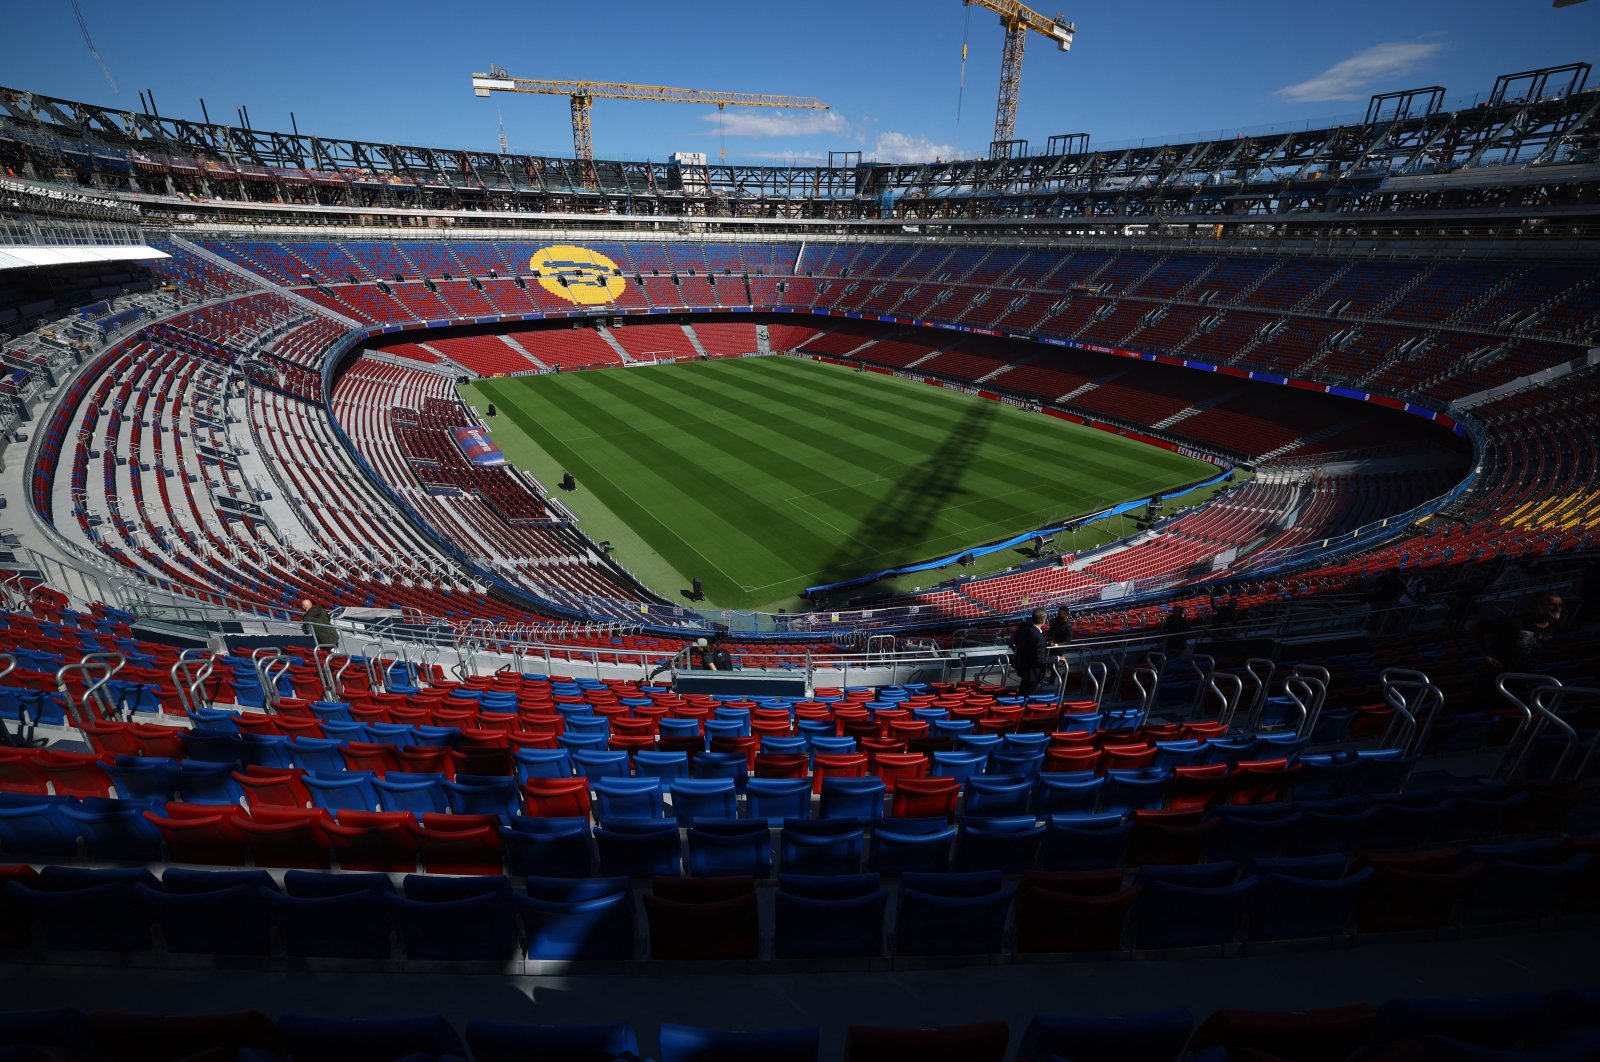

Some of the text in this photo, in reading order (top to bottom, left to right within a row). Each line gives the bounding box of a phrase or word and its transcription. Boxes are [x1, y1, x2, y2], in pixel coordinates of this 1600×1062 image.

[943, 383, 964, 393] ESTRELLA
[1000, 396, 1025, 408] ESTRELLA
[1177, 446, 1212, 463] ESTRELLA
